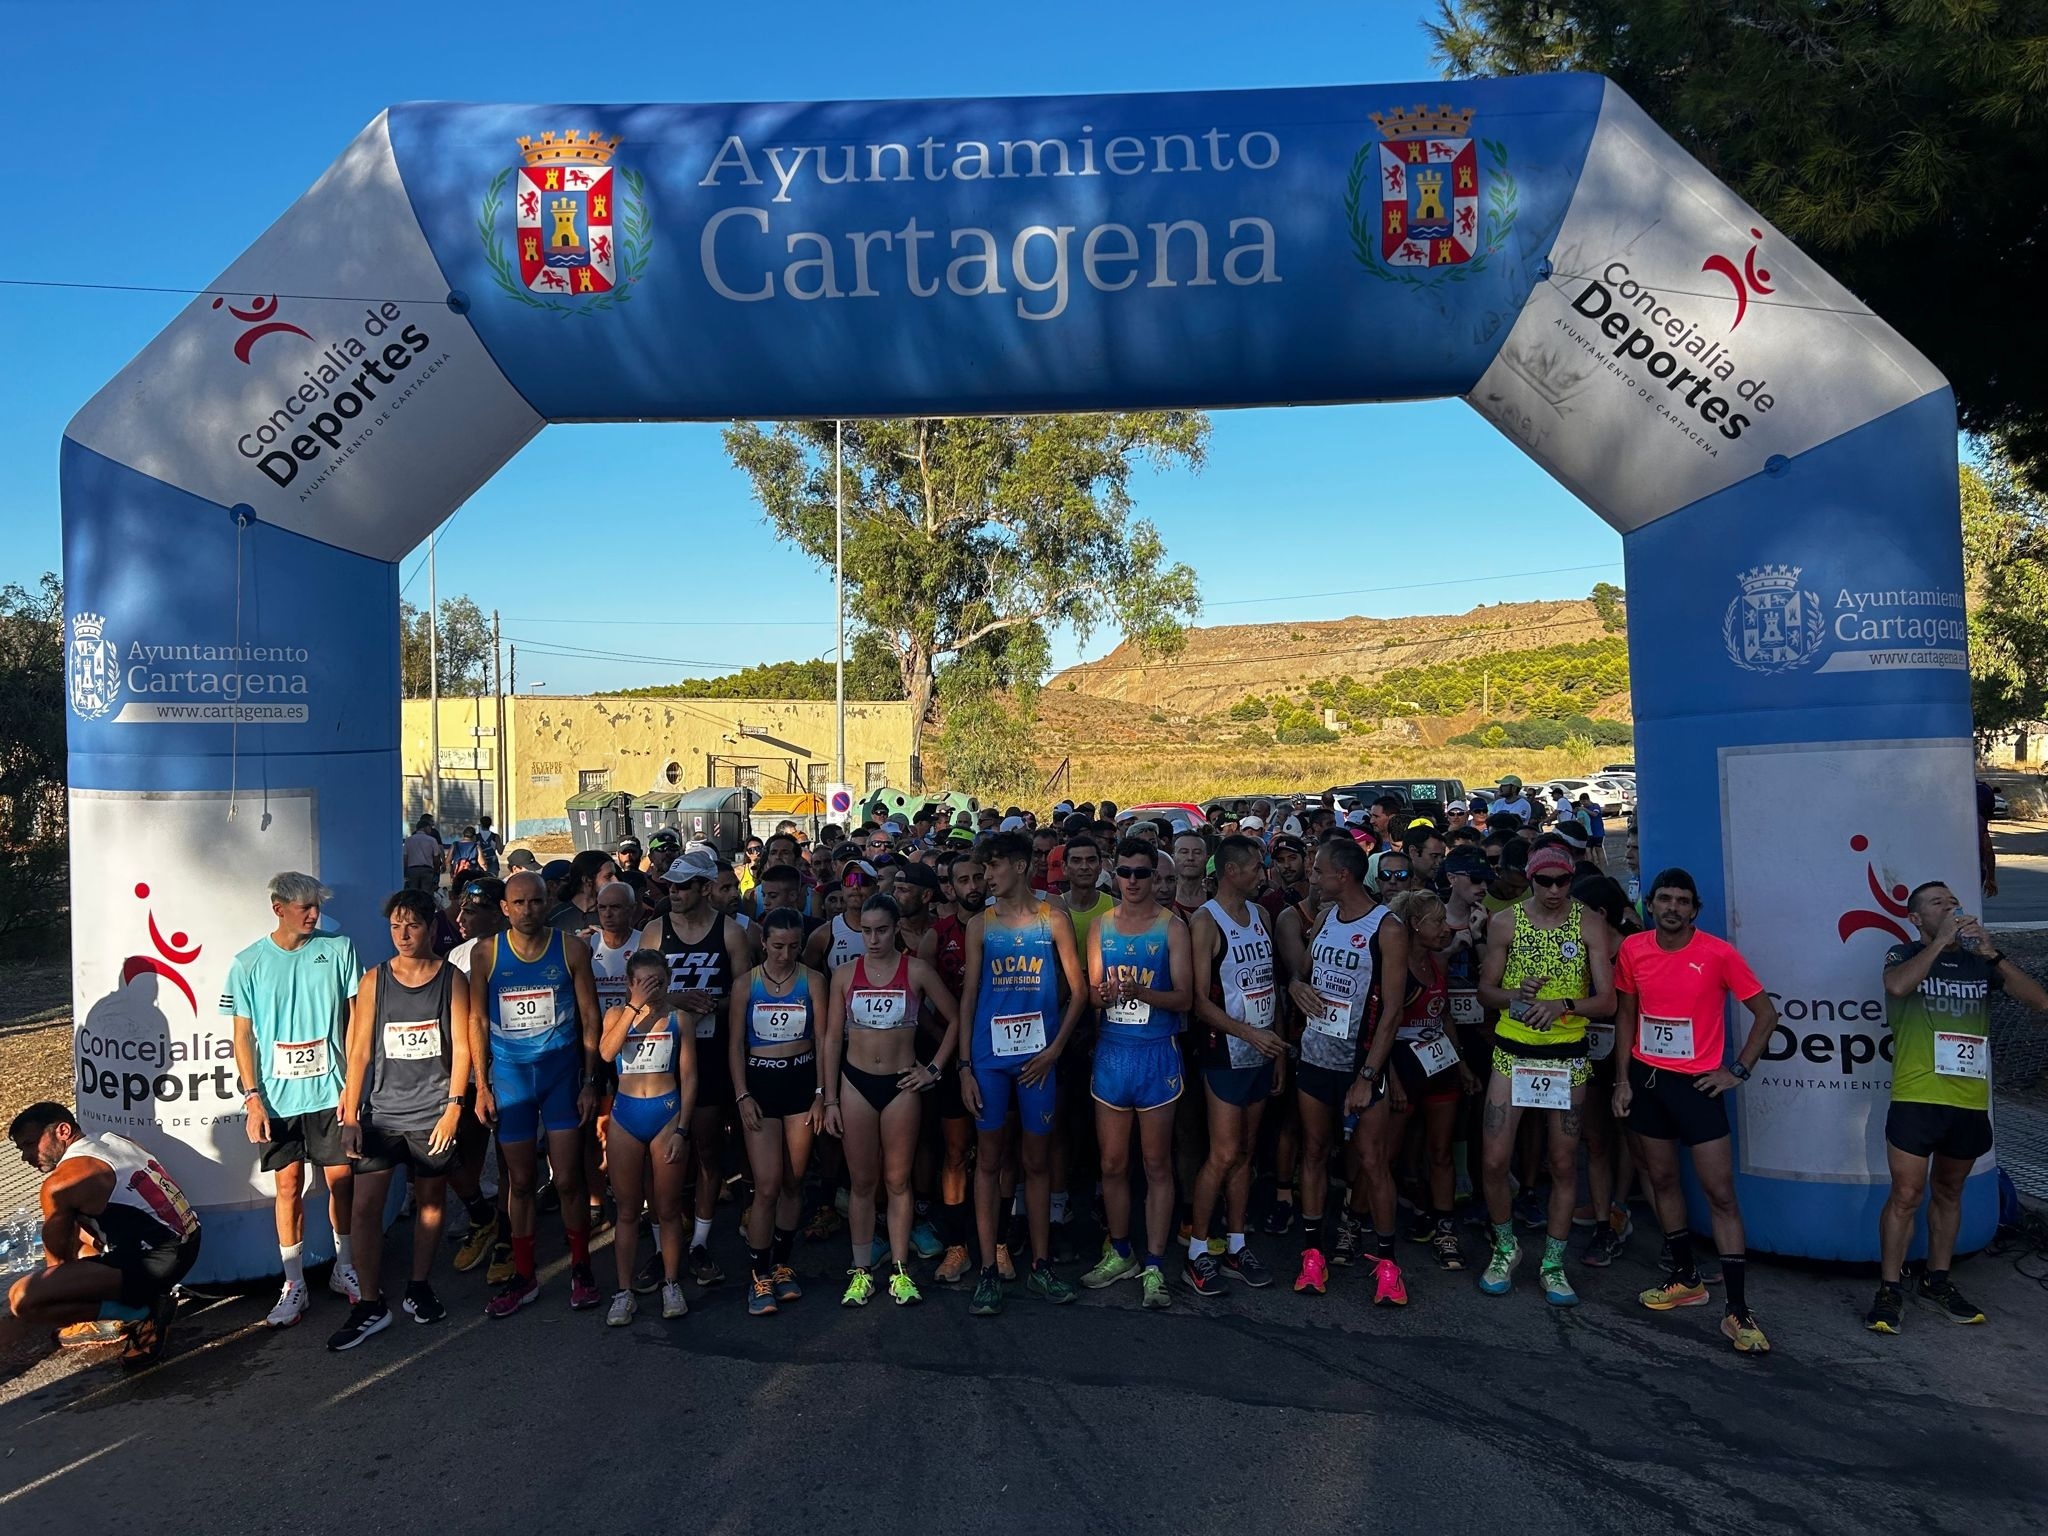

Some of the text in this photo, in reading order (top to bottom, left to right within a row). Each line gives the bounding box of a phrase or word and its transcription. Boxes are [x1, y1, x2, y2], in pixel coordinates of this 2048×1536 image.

[698, 126, 1281, 202] Ayuntamiento
[701, 206, 1283, 321] Cartagena
[1603, 260, 1775, 414] Concejalía de
[1571, 279, 1751, 440] Deportes
[237, 302, 400, 460] Concejalía de
[1555, 318, 1719, 458] AYUNTAMIENTO DE CARTAGENA
[257, 322, 431, 489] Deportes
[299, 352, 451, 503] AYUNTAMIENTO DE CARTAGENA
[1834, 586, 1964, 612] Ayuntamiento
[1833, 612, 1964, 645] Cartagena
[128, 640, 309, 665] Ayuntamiento
[127, 667, 308, 699] Cartagena
[157, 705, 304, 722] www.cartagena.es
[665, 952, 720, 967] TRI
[991, 955, 1043, 975] UCAM
[992, 976, 1040, 985] UNIVERSIDAD
[517, 1001, 535, 1015] 30
[605, 998, 622, 1009] 52
[865, 999, 892, 1013] 149
[1255, 997, 1271, 1013] 109
[770, 1012, 789, 1026] 69
[398, 1031, 428, 1047] 134
[1004, 1023, 1032, 1040] 197
[1654, 1026, 1673, 1041] 75
[81, 1028, 234, 1068] Concejalía
[636, 1043, 655, 1057] 97
[1428, 1043, 1443, 1058] 20
[1957, 1044, 1974, 1060] 23
[286, 1050, 315, 1064] 123
[757, 1060, 788, 1069] PRO
[1531, 1077, 1550, 1091] 49
[83, 1108, 163, 1126] AYUNTAMIENTO
[173, 1118, 191, 1126] DE
